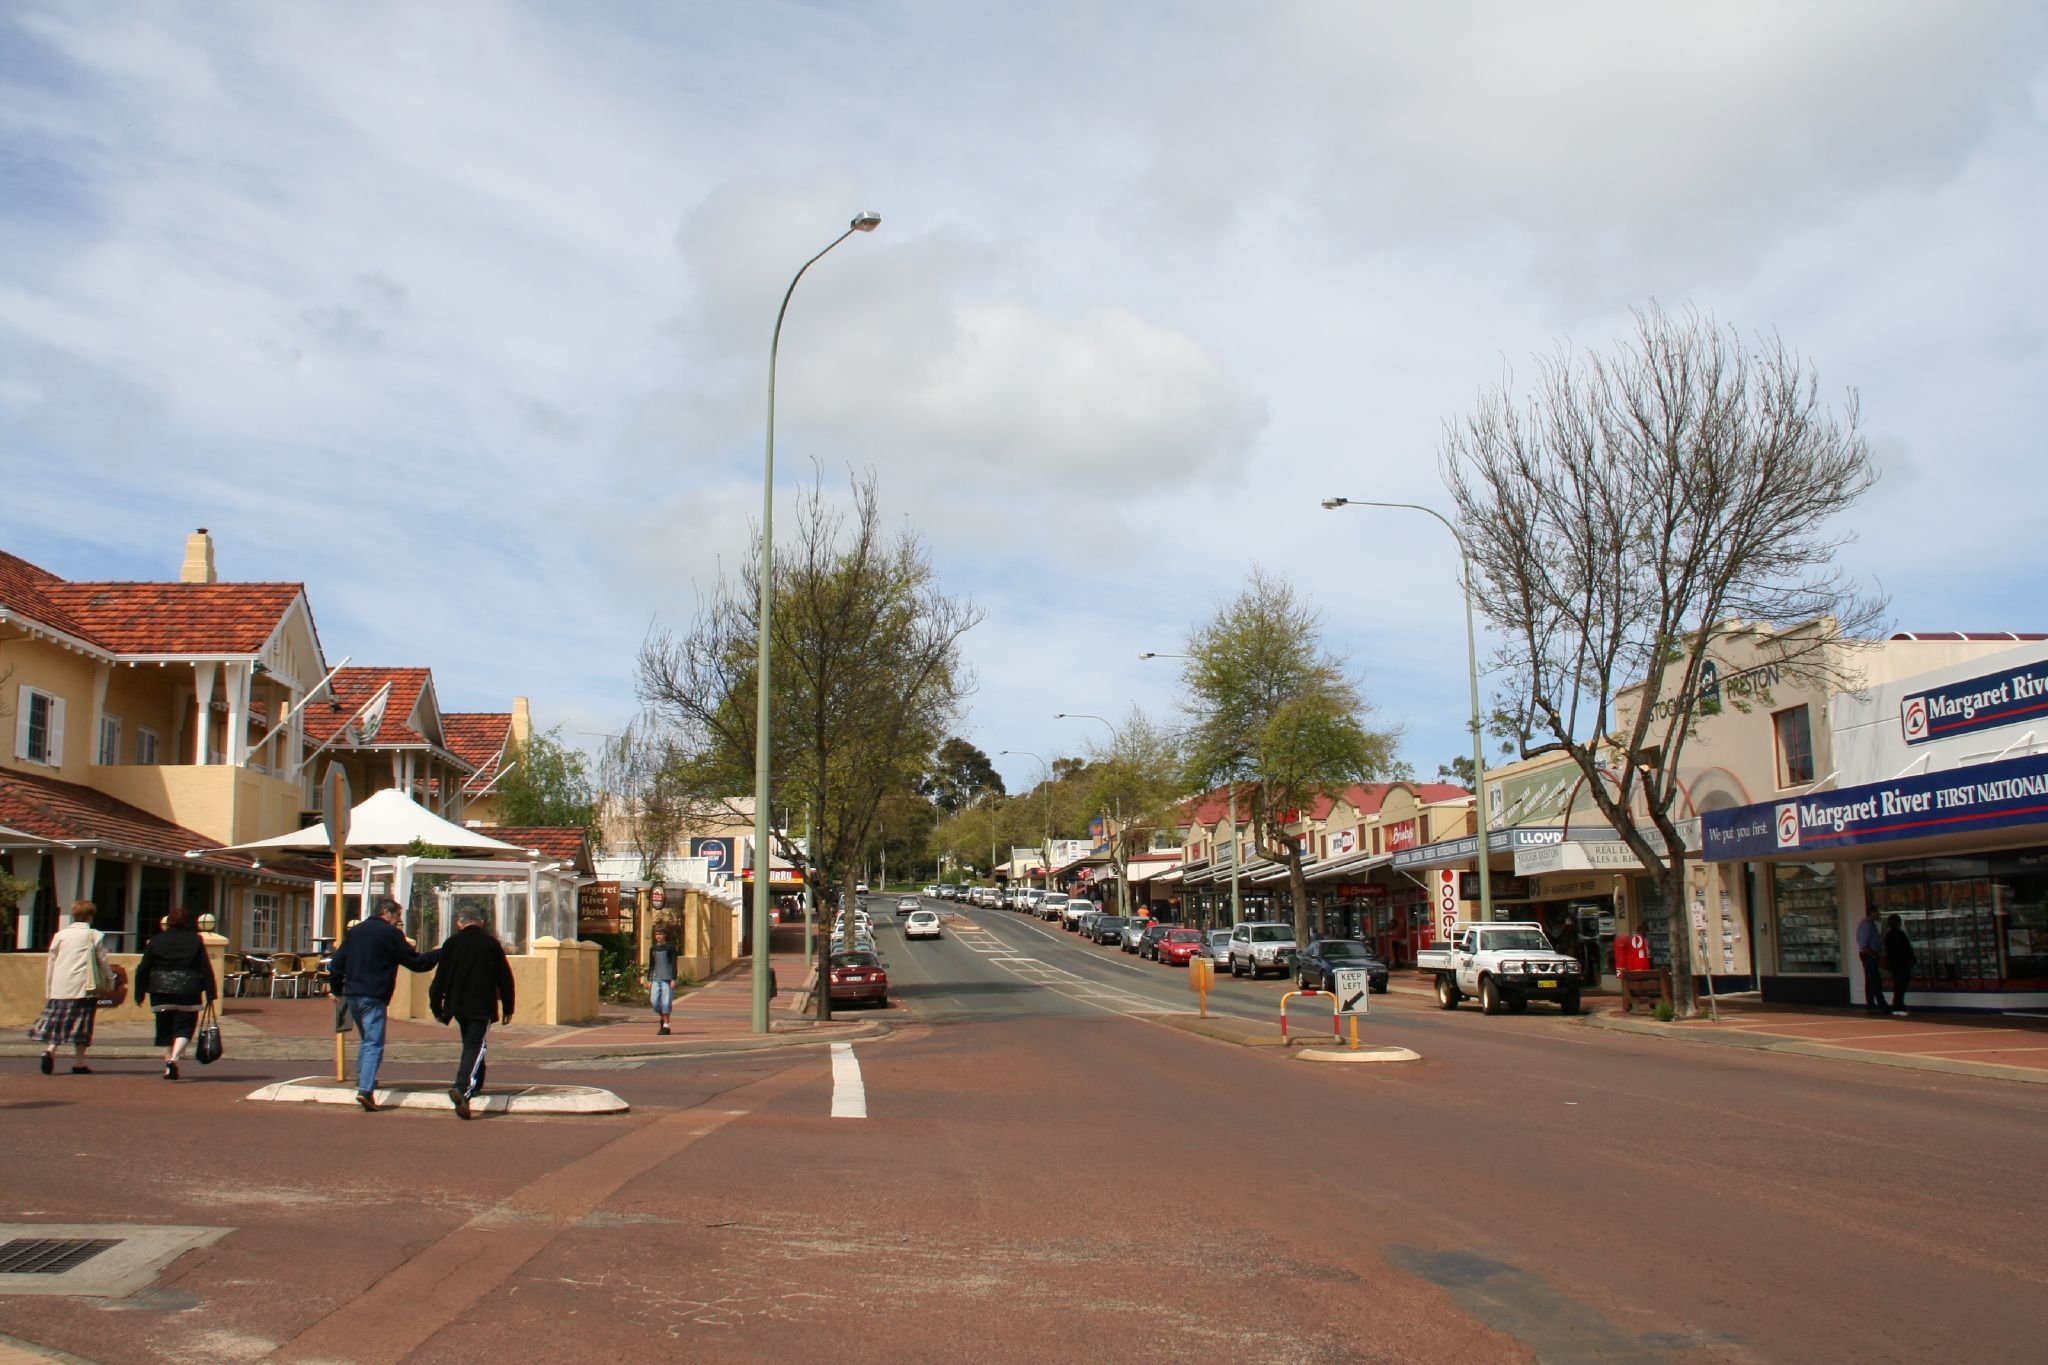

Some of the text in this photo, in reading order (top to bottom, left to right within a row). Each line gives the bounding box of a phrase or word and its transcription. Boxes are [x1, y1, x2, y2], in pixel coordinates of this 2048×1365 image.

[1727, 664, 1780, 699] PRESTON
[1928, 681, 2010, 719] Margaret
[1801, 796, 1878, 832] Margaret
[1880, 788, 1931, 817] River
[1936, 785, 1975, 809] FIRST
[1709, 827, 1721, 841] We
[1722, 828, 1734, 844] put
[1736, 826, 1750, 842] you
[1595, 846, 1617, 855] REAL
[1586, 855, 1611, 864] SALES
[580, 885, 617, 895] argaret
[581, 895, 608, 905] River
[582, 906, 609, 916] Hotel
[1441, 884, 1457, 939] coles
[1341, 973, 1361, 981] KEEP
[1343, 982, 1361, 990] LEFT
